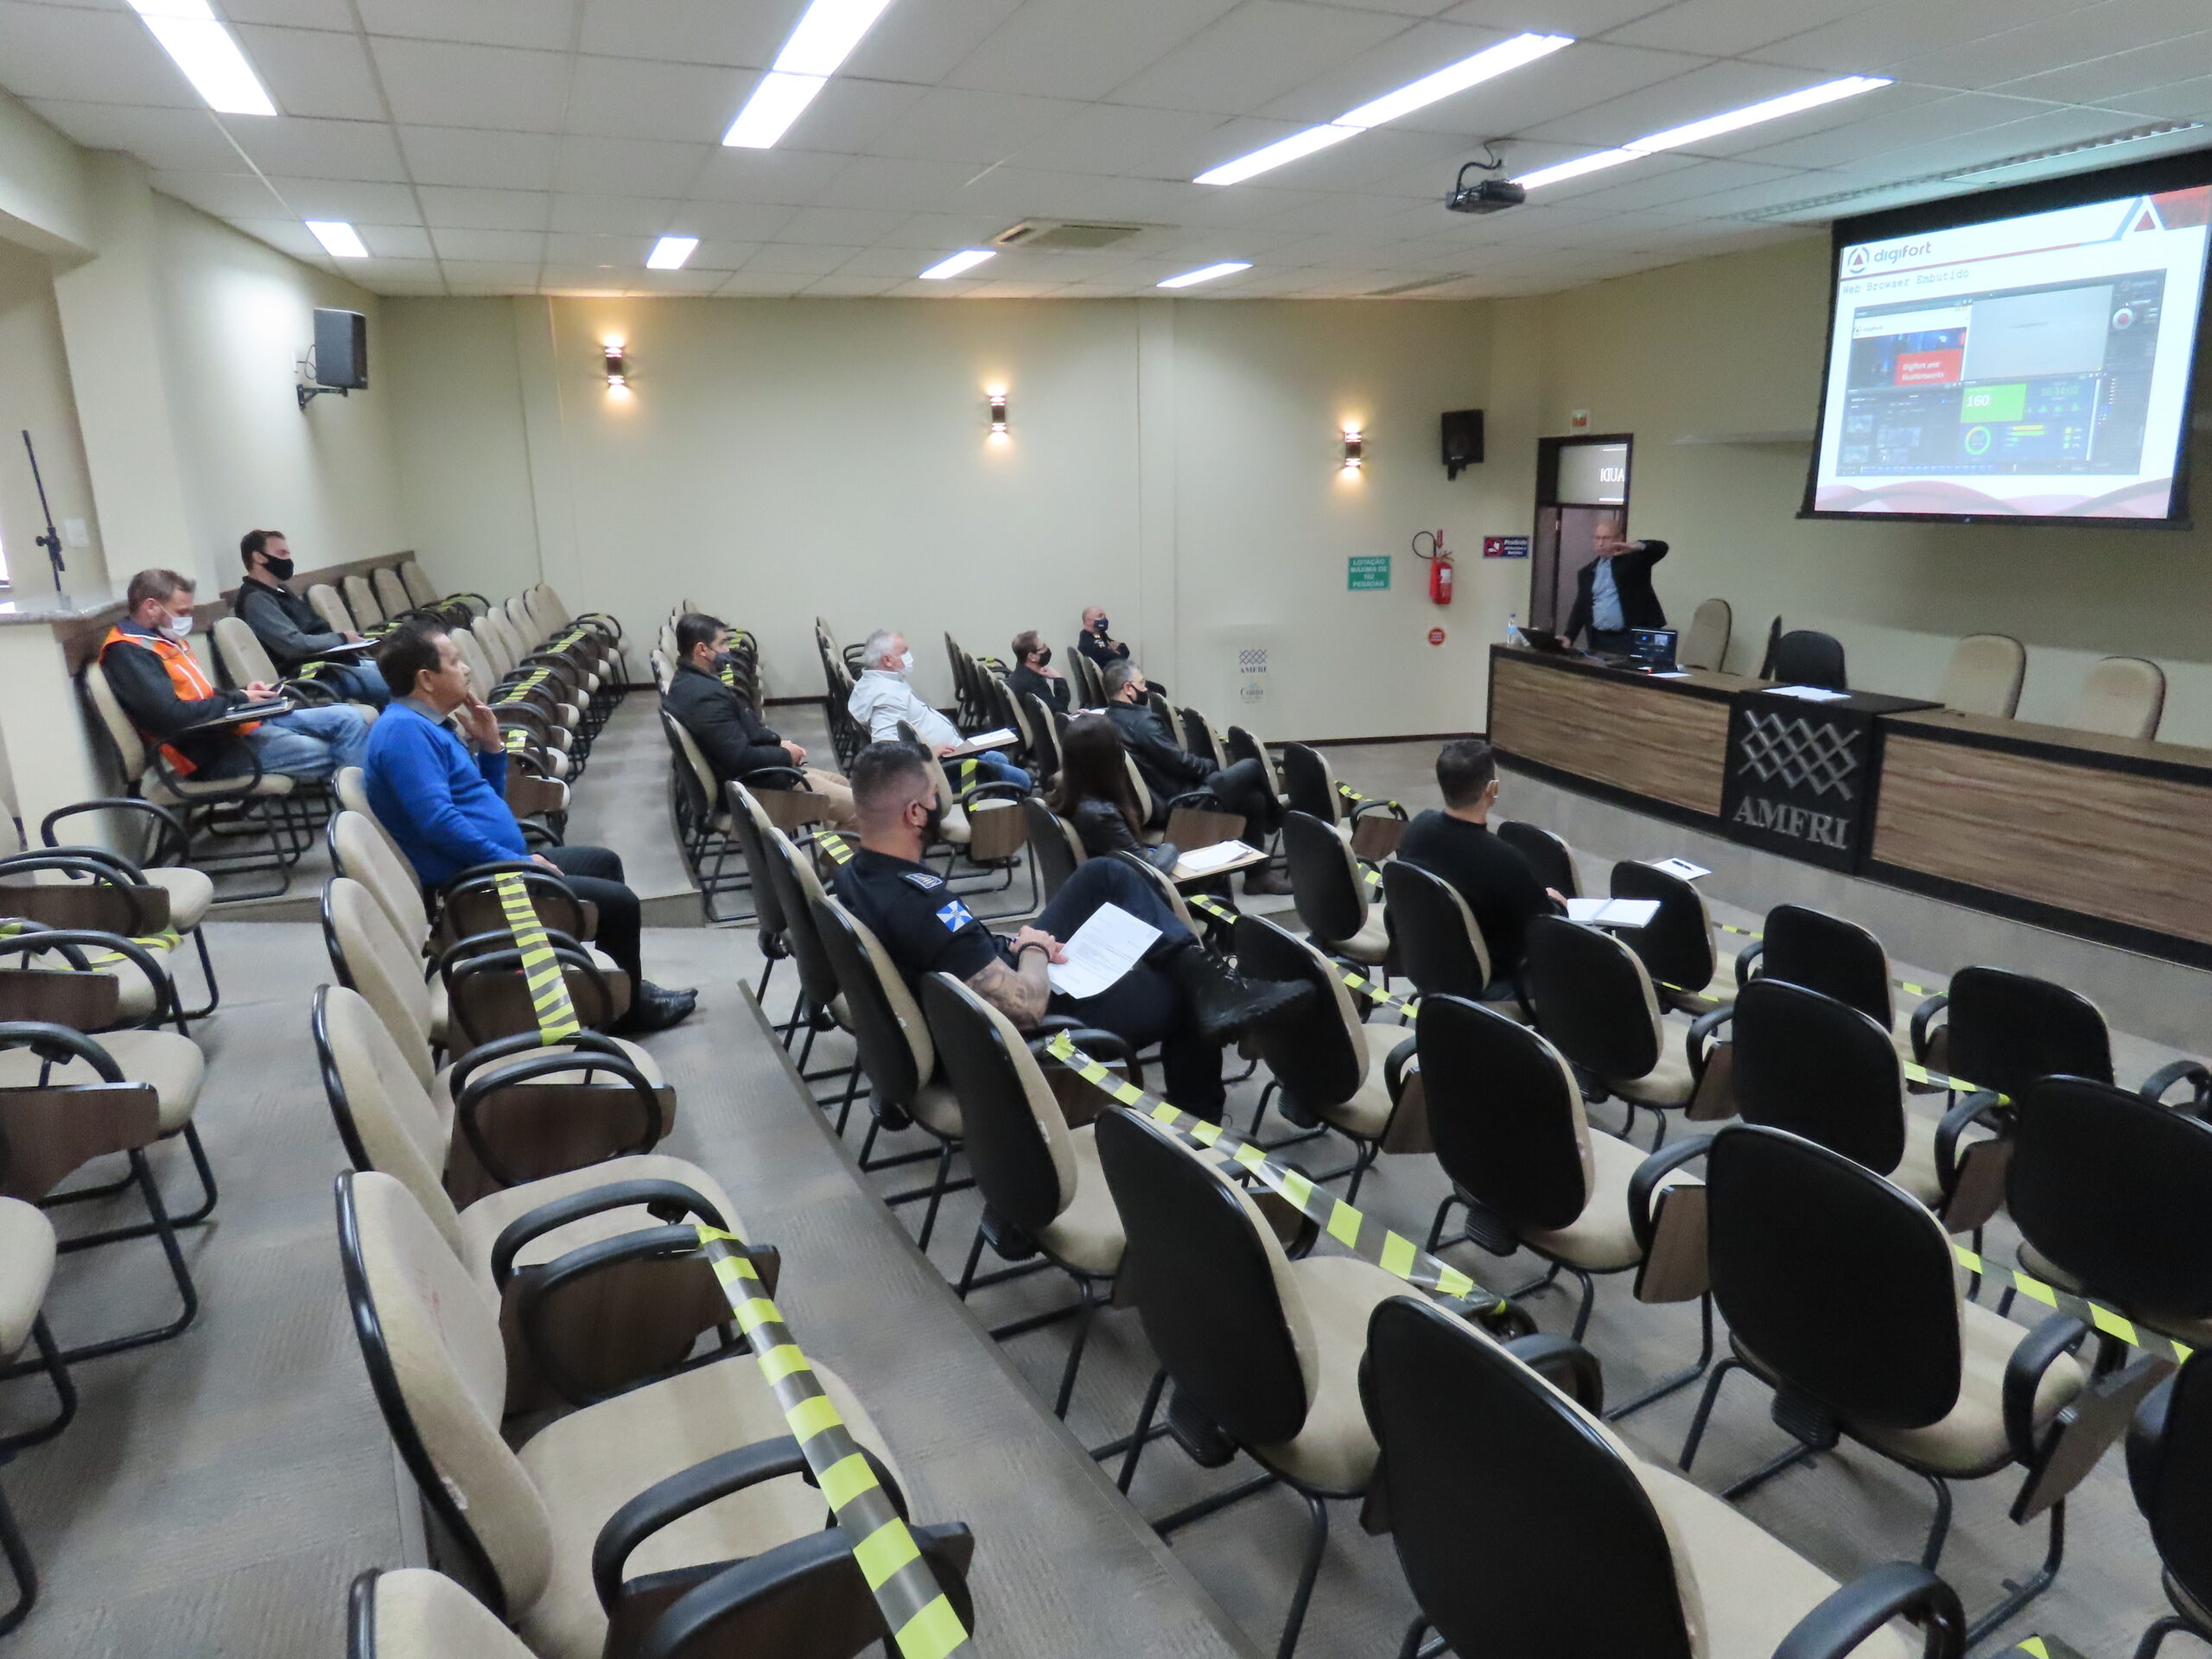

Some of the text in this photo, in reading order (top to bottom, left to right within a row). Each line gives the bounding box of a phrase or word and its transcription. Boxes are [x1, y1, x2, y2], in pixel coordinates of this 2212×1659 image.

[1873, 241, 1932, 264] digifort
[1843, 269, 1969, 294] Web Browser Embutido
[1967, 394, 1990, 407] 160
[1352, 557, 1386, 566] LOTAÇÃO
[1732, 795, 1850, 849] AMFRI
